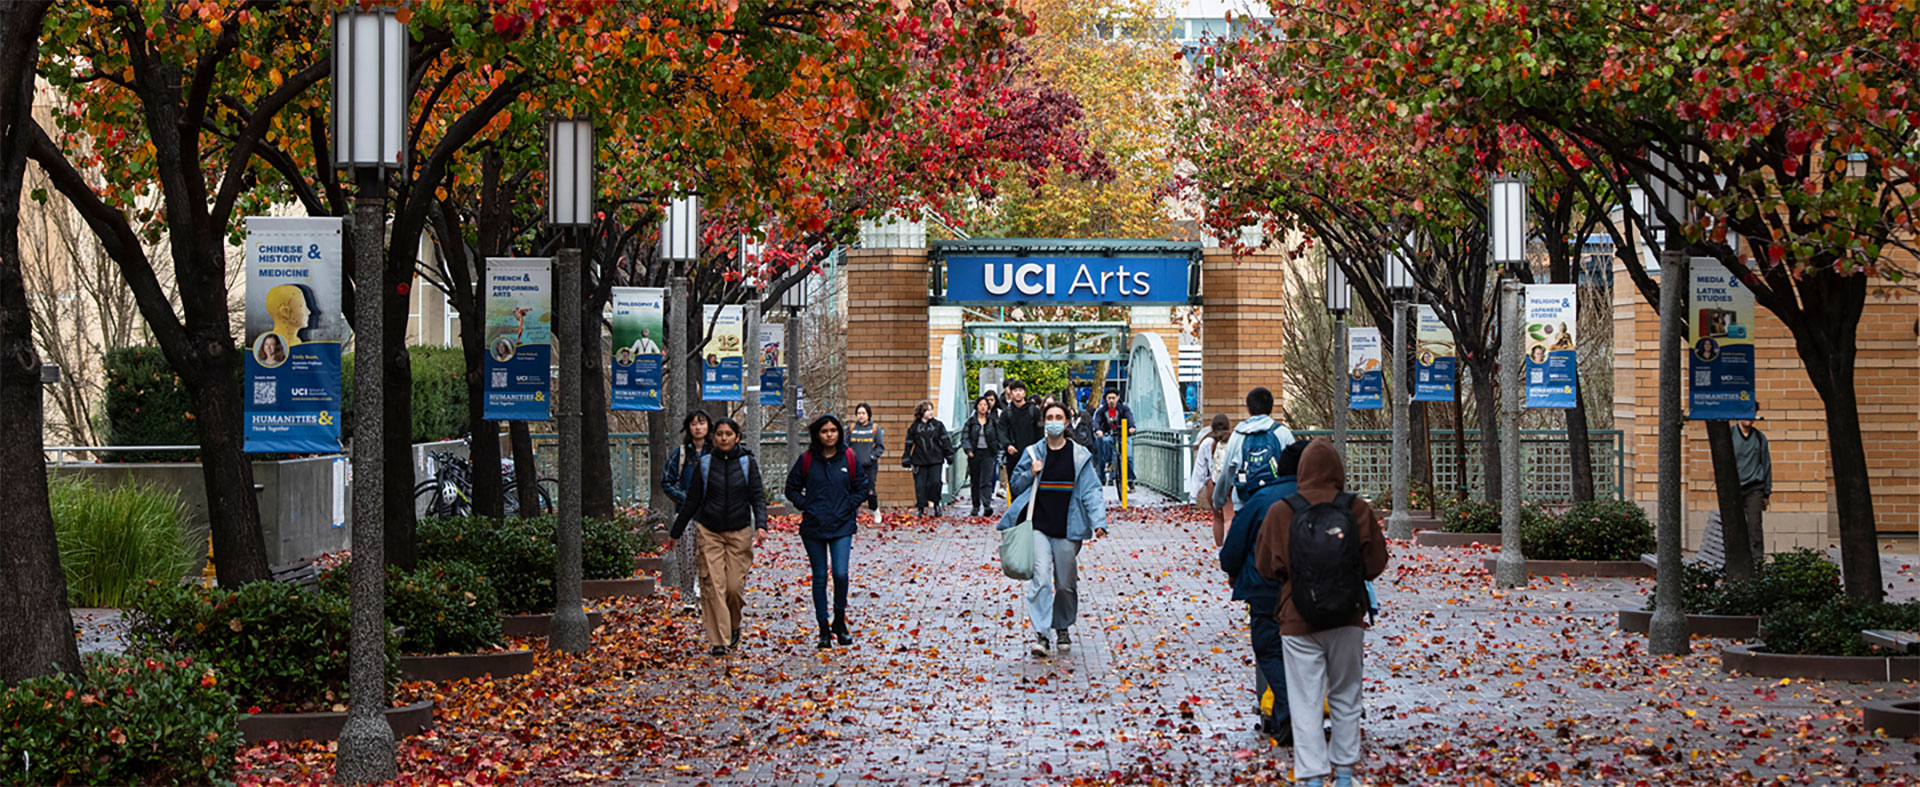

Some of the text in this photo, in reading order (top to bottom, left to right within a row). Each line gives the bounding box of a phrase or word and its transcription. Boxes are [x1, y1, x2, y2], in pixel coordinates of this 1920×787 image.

[258, 244, 322, 260] CHINESE &
[258, 254, 303, 263] HISTORY
[258, 268, 310, 278] MEDICINE
[523, 273, 530, 282] &
[984, 263, 1150, 296] UCI Arts
[1728, 276, 1739, 288] &
[1562, 298, 1570, 308] &
[291, 388, 308, 396] UCI
[535, 391, 545, 402] &
[1740, 390, 1750, 401] &
[252, 410, 333, 425] HUMANITIES &
